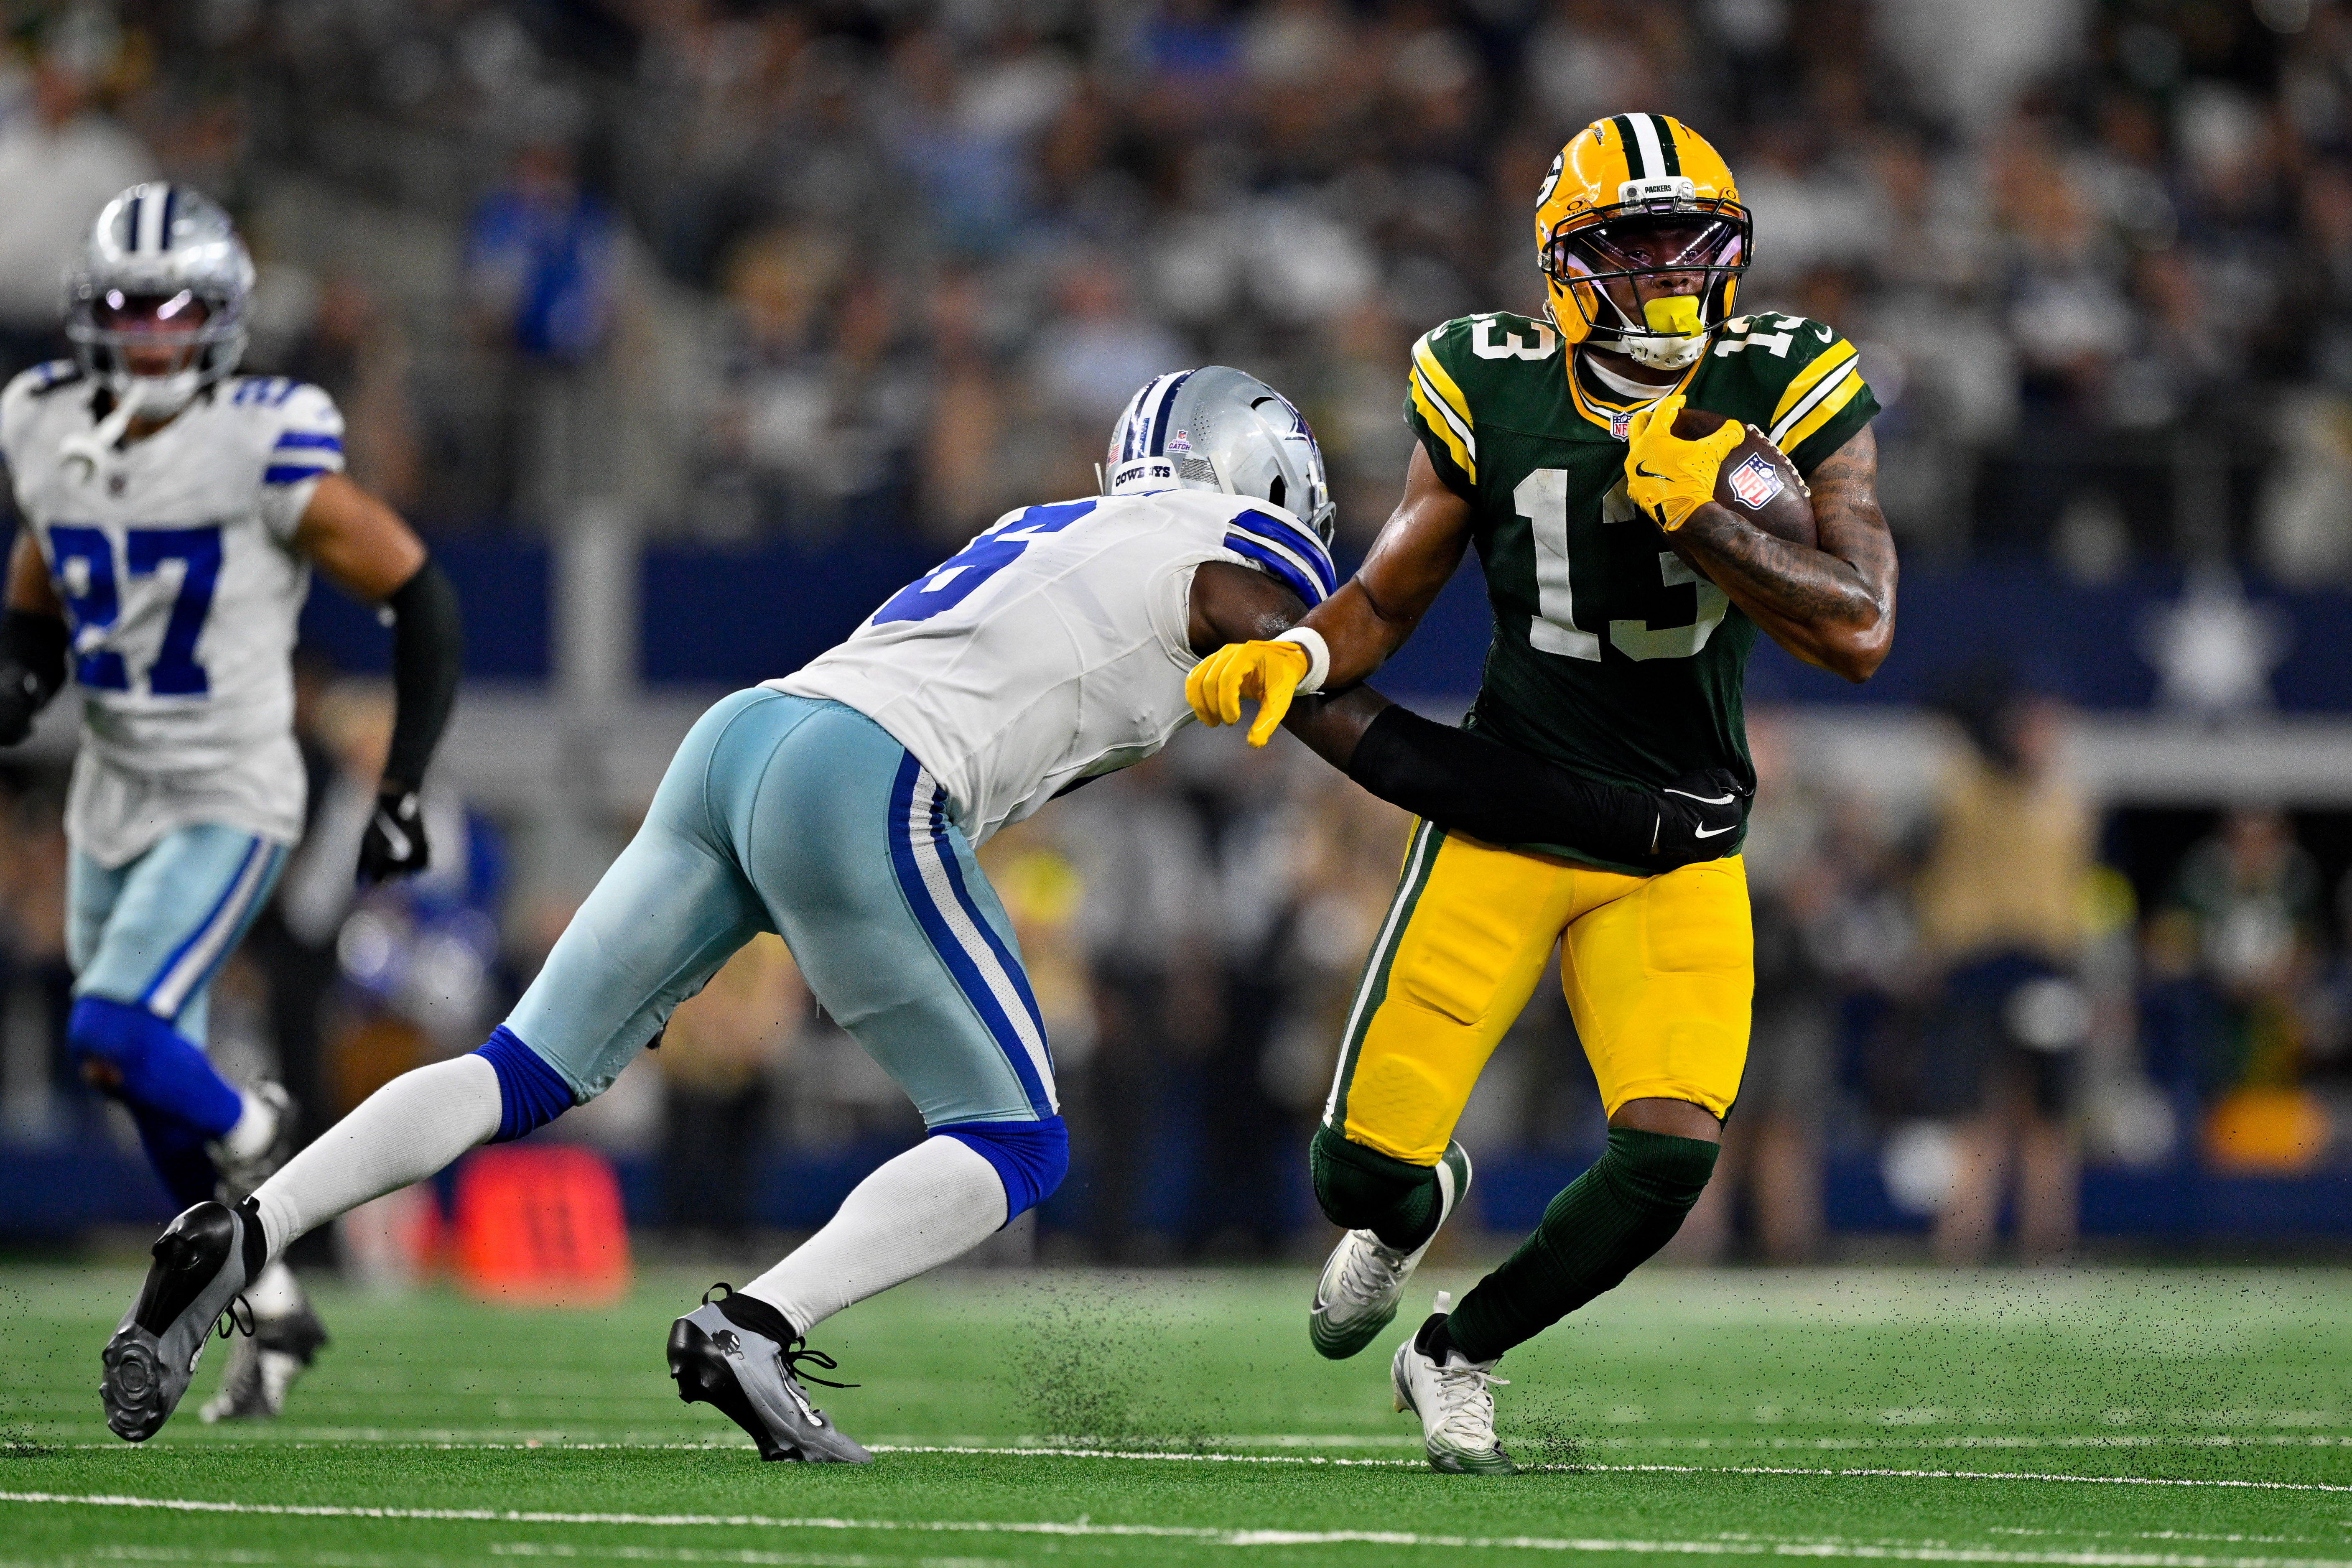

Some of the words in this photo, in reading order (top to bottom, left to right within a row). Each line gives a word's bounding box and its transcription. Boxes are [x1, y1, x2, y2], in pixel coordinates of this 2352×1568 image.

[1645, 185, 1672, 194] PACKERS
[1469, 311, 1556, 361] 3
[1615, 423, 1629, 436] NF
[1734, 467, 1767, 504] NFL
[871, 499, 1097, 626] 6
[1513, 468, 1730, 662] 13
[48, 525, 222, 694] 27
